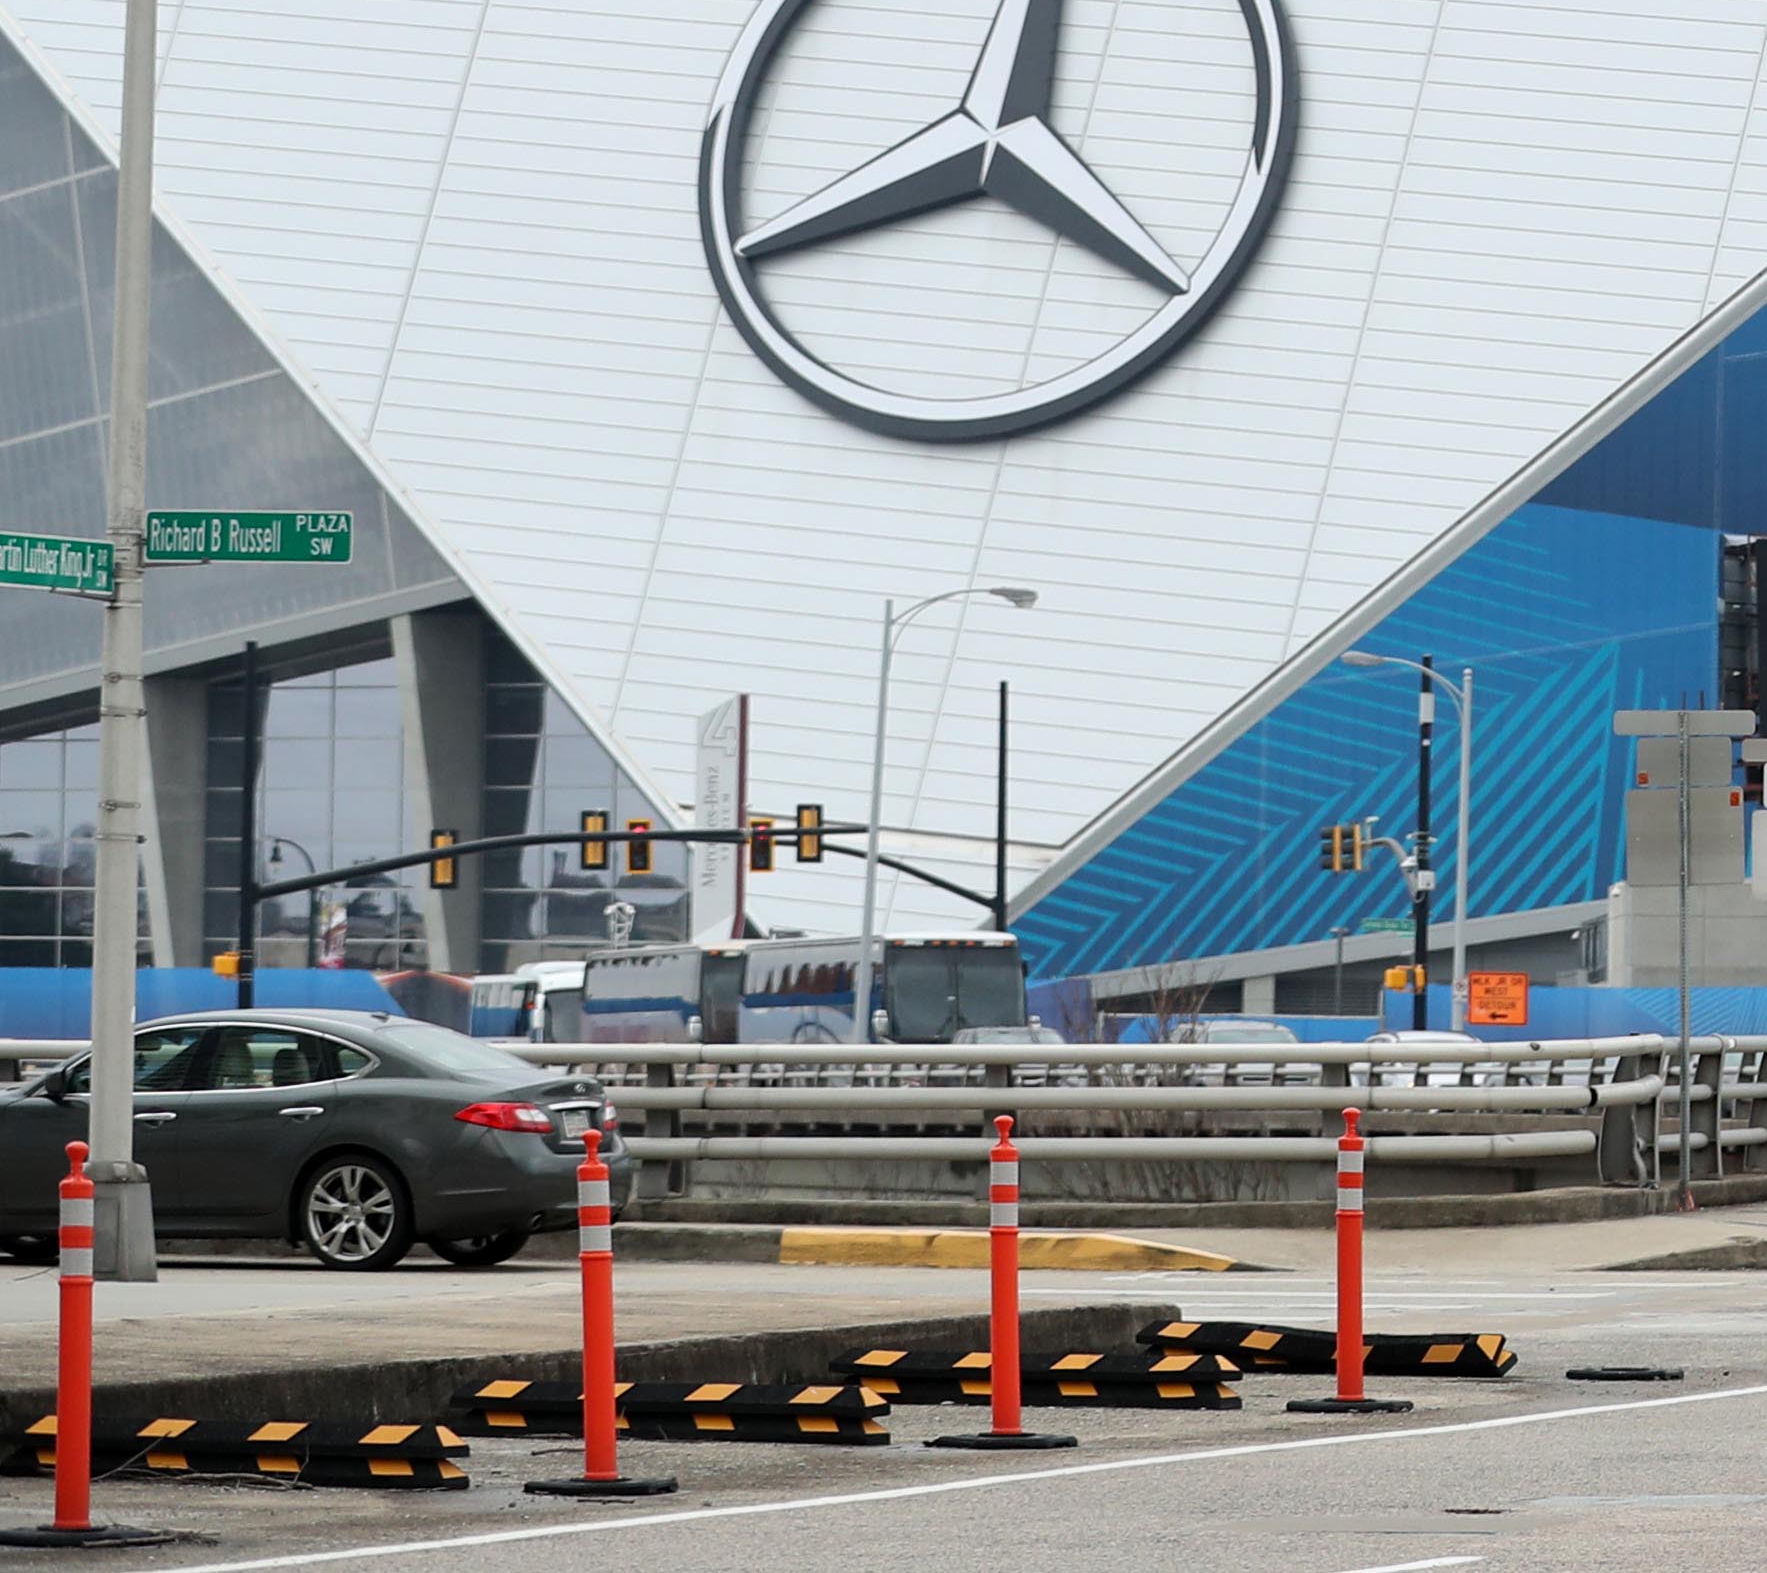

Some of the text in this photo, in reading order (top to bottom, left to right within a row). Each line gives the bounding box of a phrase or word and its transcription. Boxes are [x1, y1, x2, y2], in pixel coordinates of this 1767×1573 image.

[151, 518, 282, 553] Richard B Russell
[296, 515, 349, 533] PLAZA
[311, 537, 333, 556] SW
[24, 539, 59, 576] Luther
[60, 542, 83, 588] King
